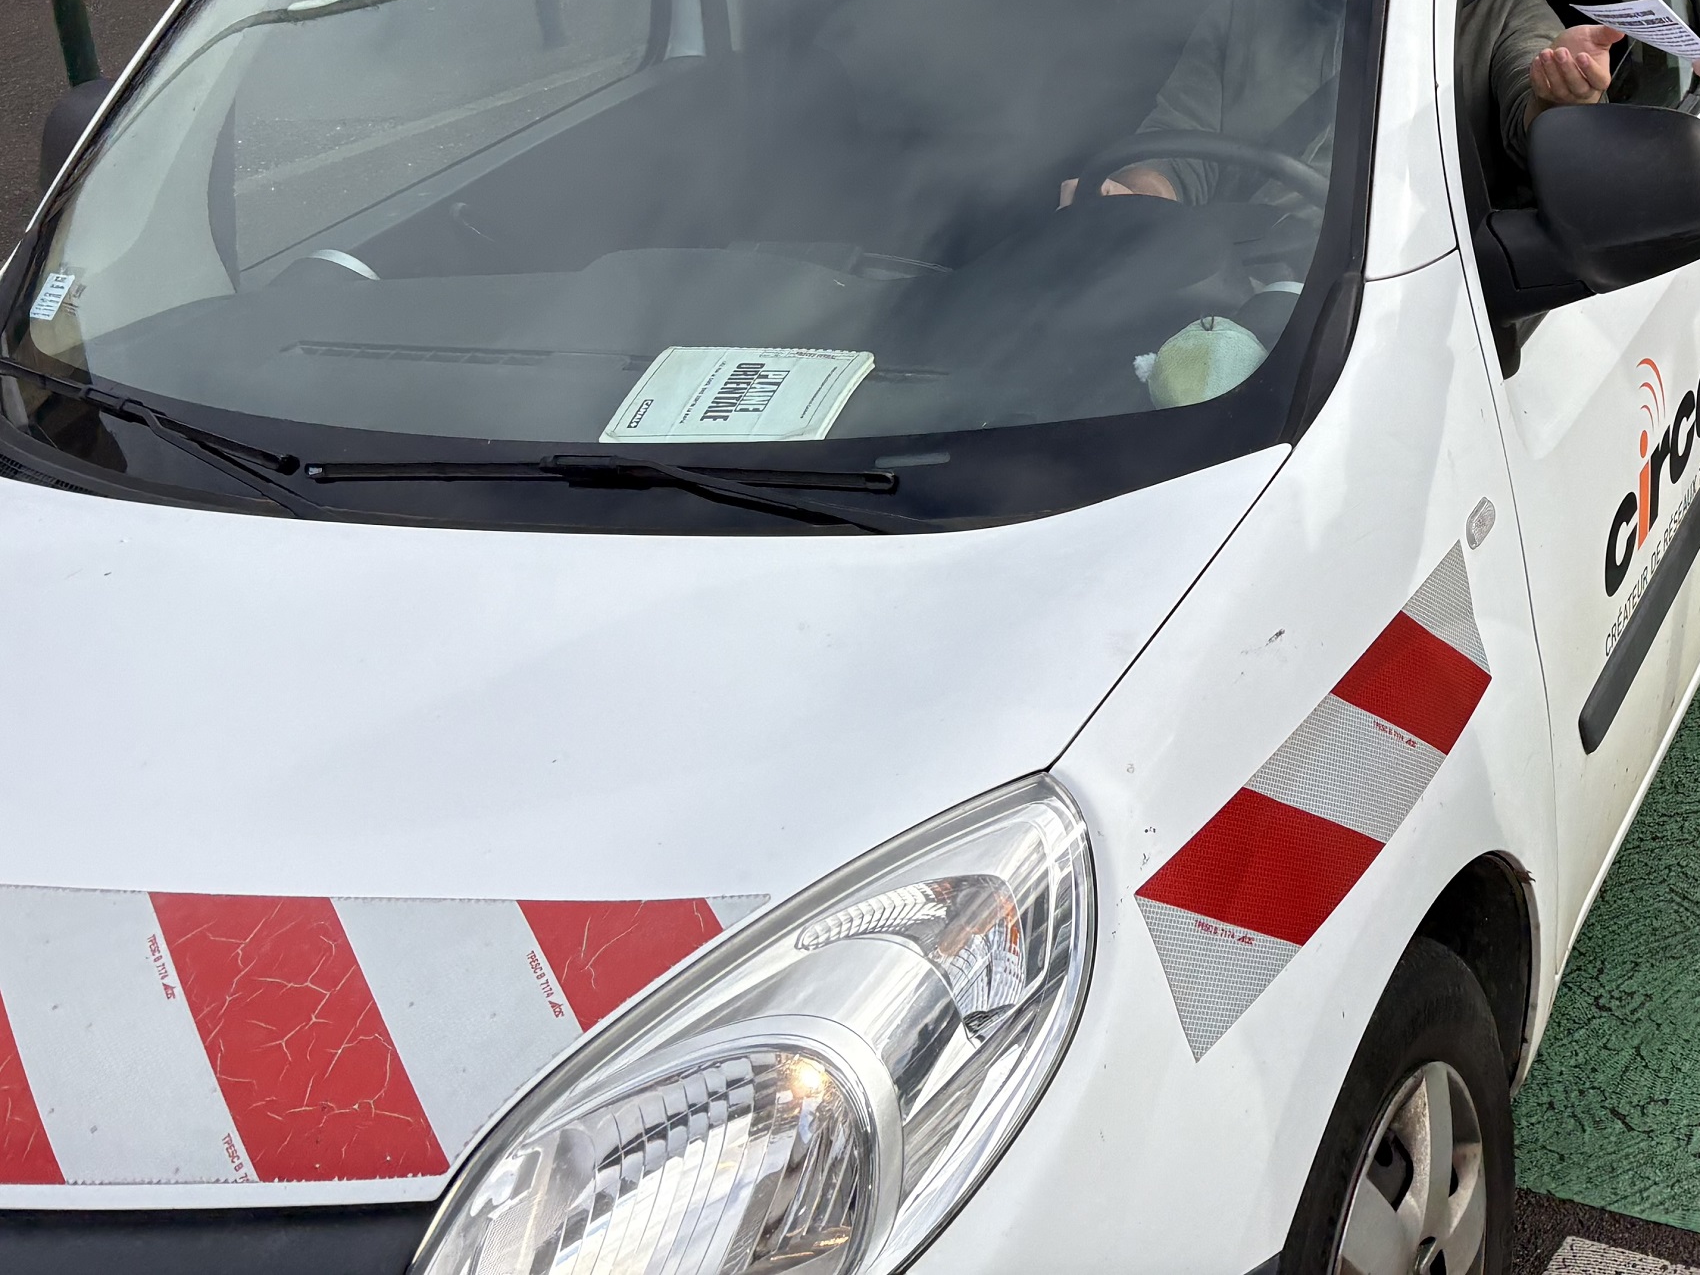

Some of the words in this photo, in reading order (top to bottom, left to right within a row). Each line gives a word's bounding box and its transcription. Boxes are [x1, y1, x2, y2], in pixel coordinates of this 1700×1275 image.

[700, 362, 766, 422] ORIENTALE
[734, 370, 790, 413] PLAINE
[1605, 565, 1649, 657] CRÉATEUR
[1650, 540, 1662, 576] DE
[1663, 474, 1698, 553] RÉSEAUX
